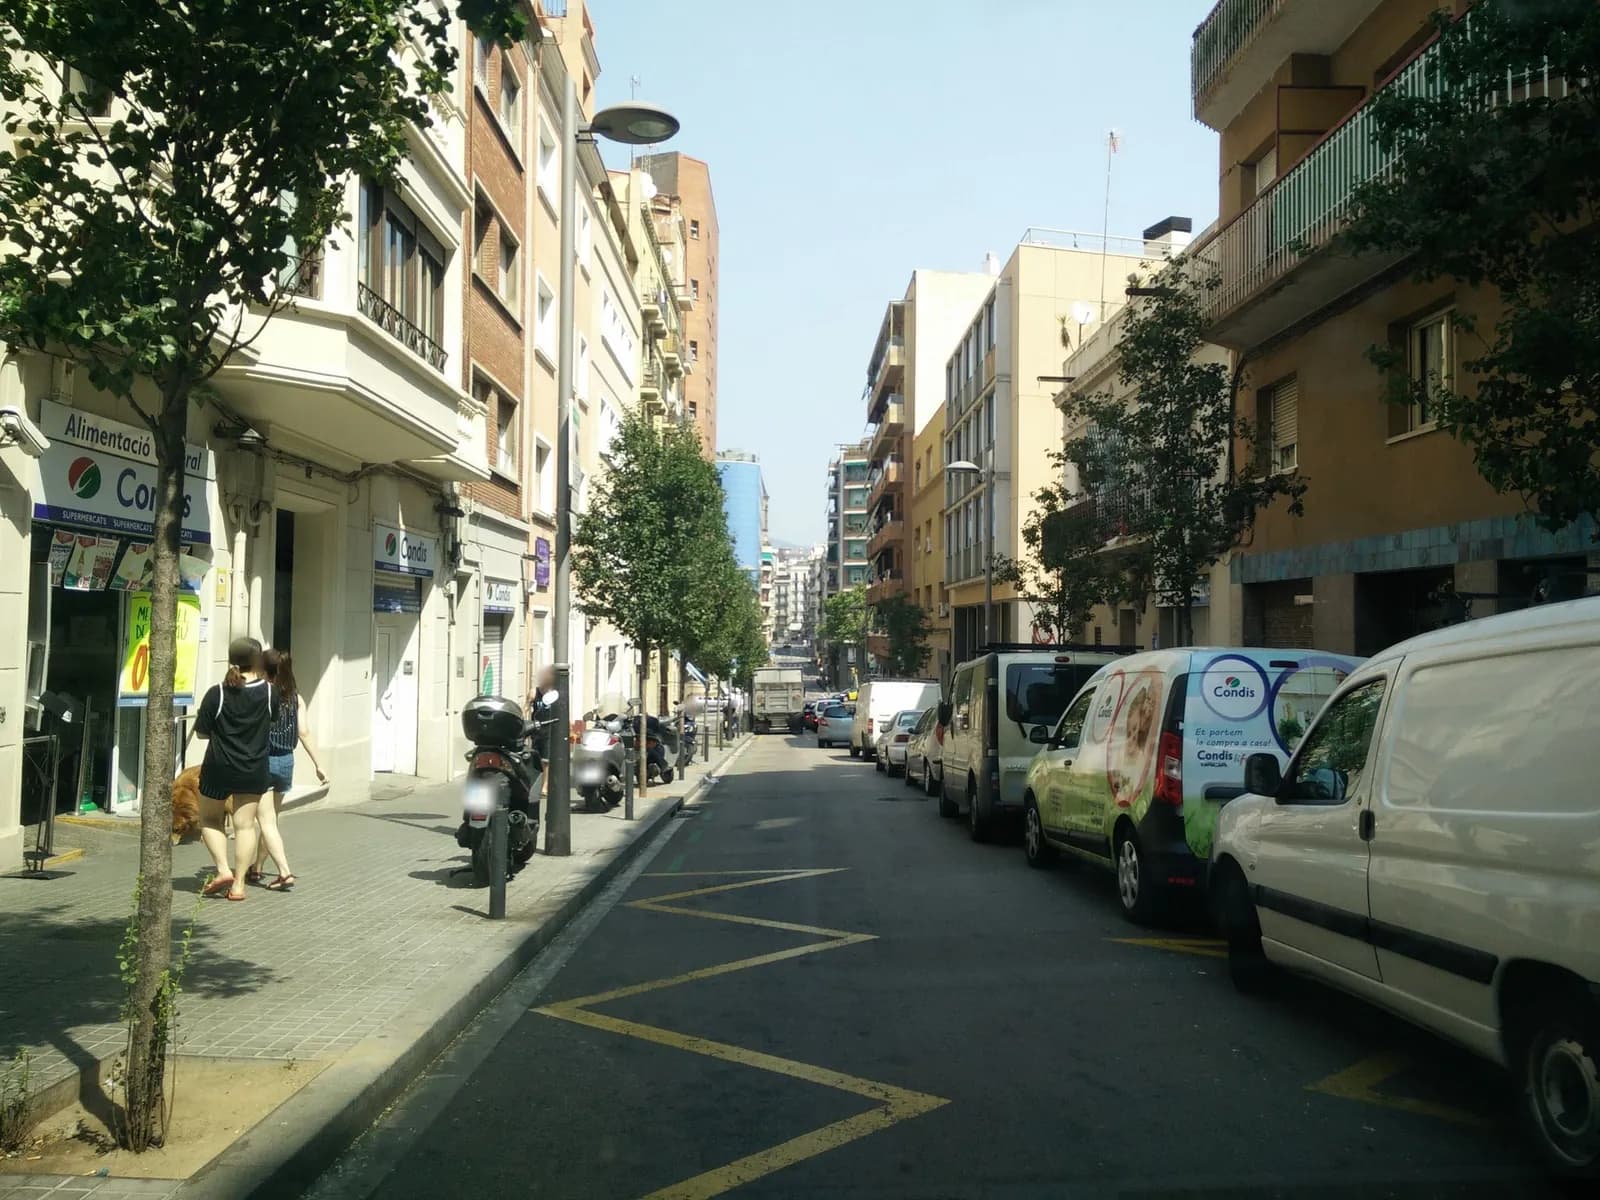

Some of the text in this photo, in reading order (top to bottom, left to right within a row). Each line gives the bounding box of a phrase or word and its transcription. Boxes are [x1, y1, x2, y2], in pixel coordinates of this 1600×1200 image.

[64, 413, 151, 457] Alimentació
[62, 509, 153, 533] SUPERMERCATS SUPERMERCATS
[401, 536, 427, 562] Condis
[1213, 686, 1256, 698] Condis
[1195, 728, 1243, 738] Et portem
[1206, 740, 1240, 748] compra
[1250, 739, 1272, 748] casa!
[1197, 750, 1233, 761] Condis
